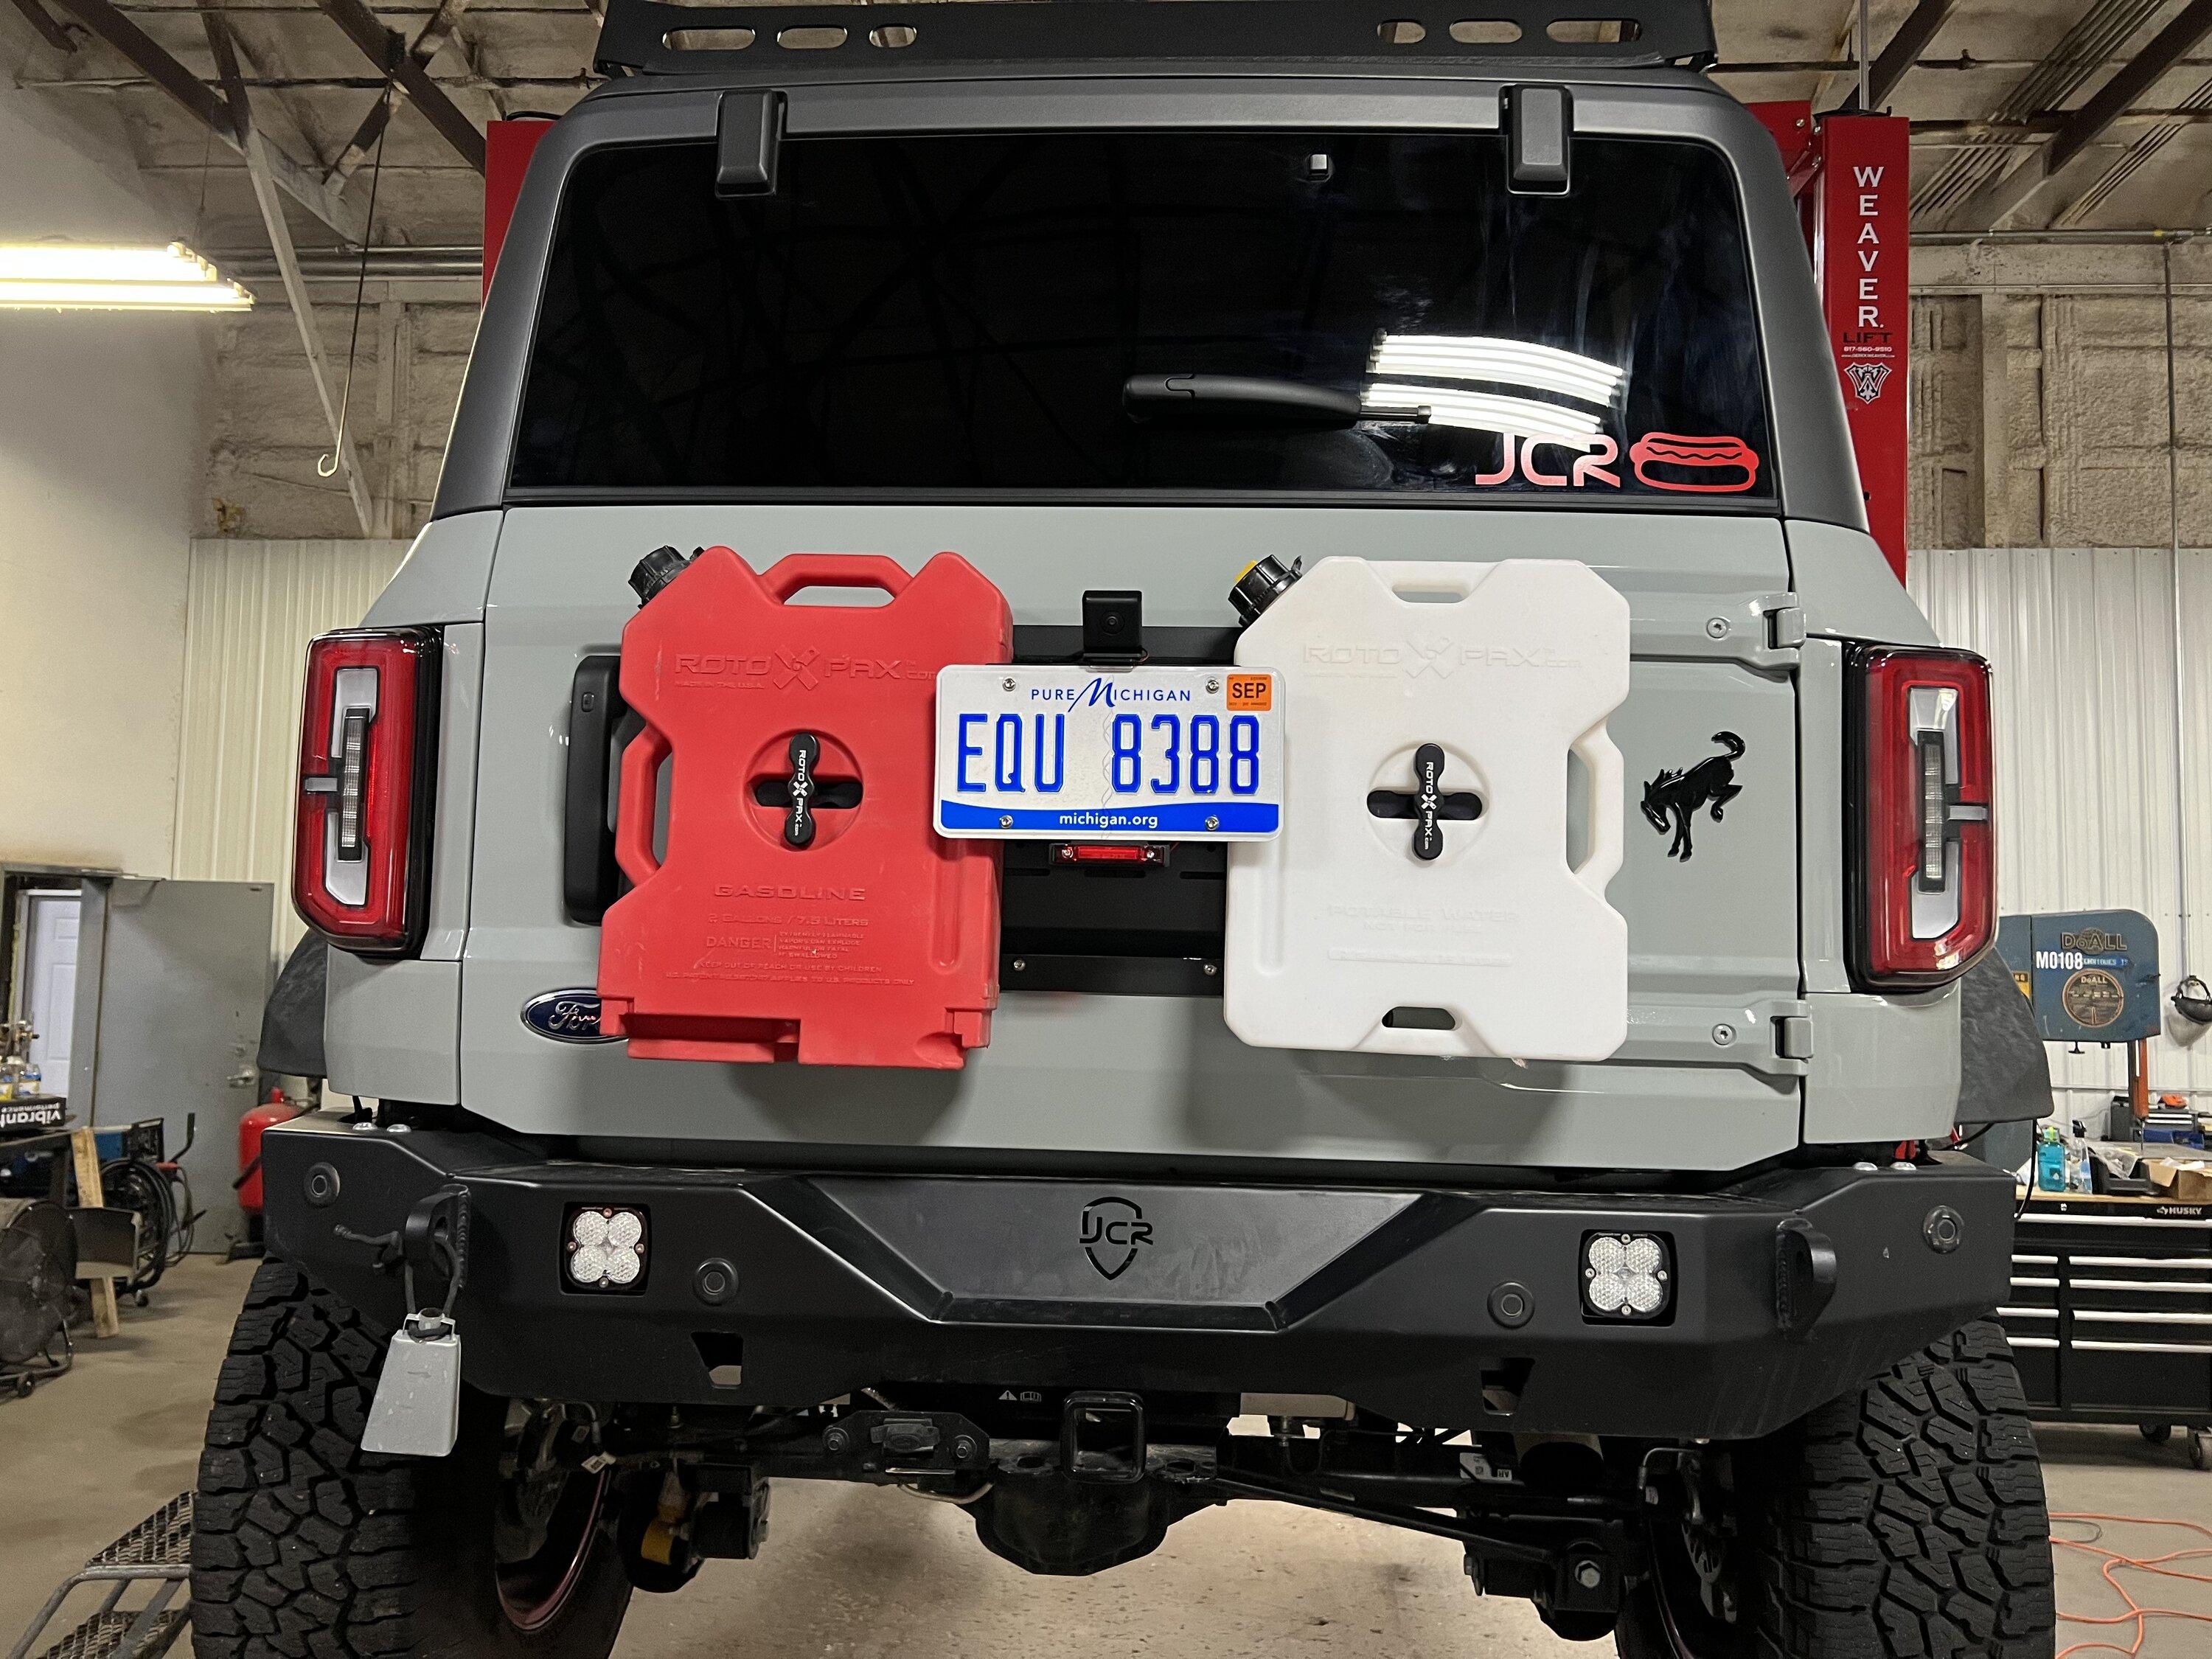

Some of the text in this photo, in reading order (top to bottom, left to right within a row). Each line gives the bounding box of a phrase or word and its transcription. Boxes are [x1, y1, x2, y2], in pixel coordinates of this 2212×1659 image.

[1843, 332, 1893, 343] LIFT
[1475, 431, 1621, 487] JCR
[675, 653, 771, 675] ROTO
[1032, 677, 1191, 712] PURE MICHIGAN
[1232, 683, 1266, 698] SEP
[957, 713, 1259, 795] EQU 8388
[798, 749, 807, 782] ROTO
[1426, 762, 1434, 794] ROTO
[1059, 813, 1158, 829] michigan.org
[714, 884, 866, 900] GASOLINE
[722, 914, 783, 924] GALLONS
[824, 917, 869, 926] LITERS
[706, 936, 773, 949] DANGER
[2168, 1206, 2202, 1215] HUSKY
[1079, 1216, 1153, 1245] JCR
